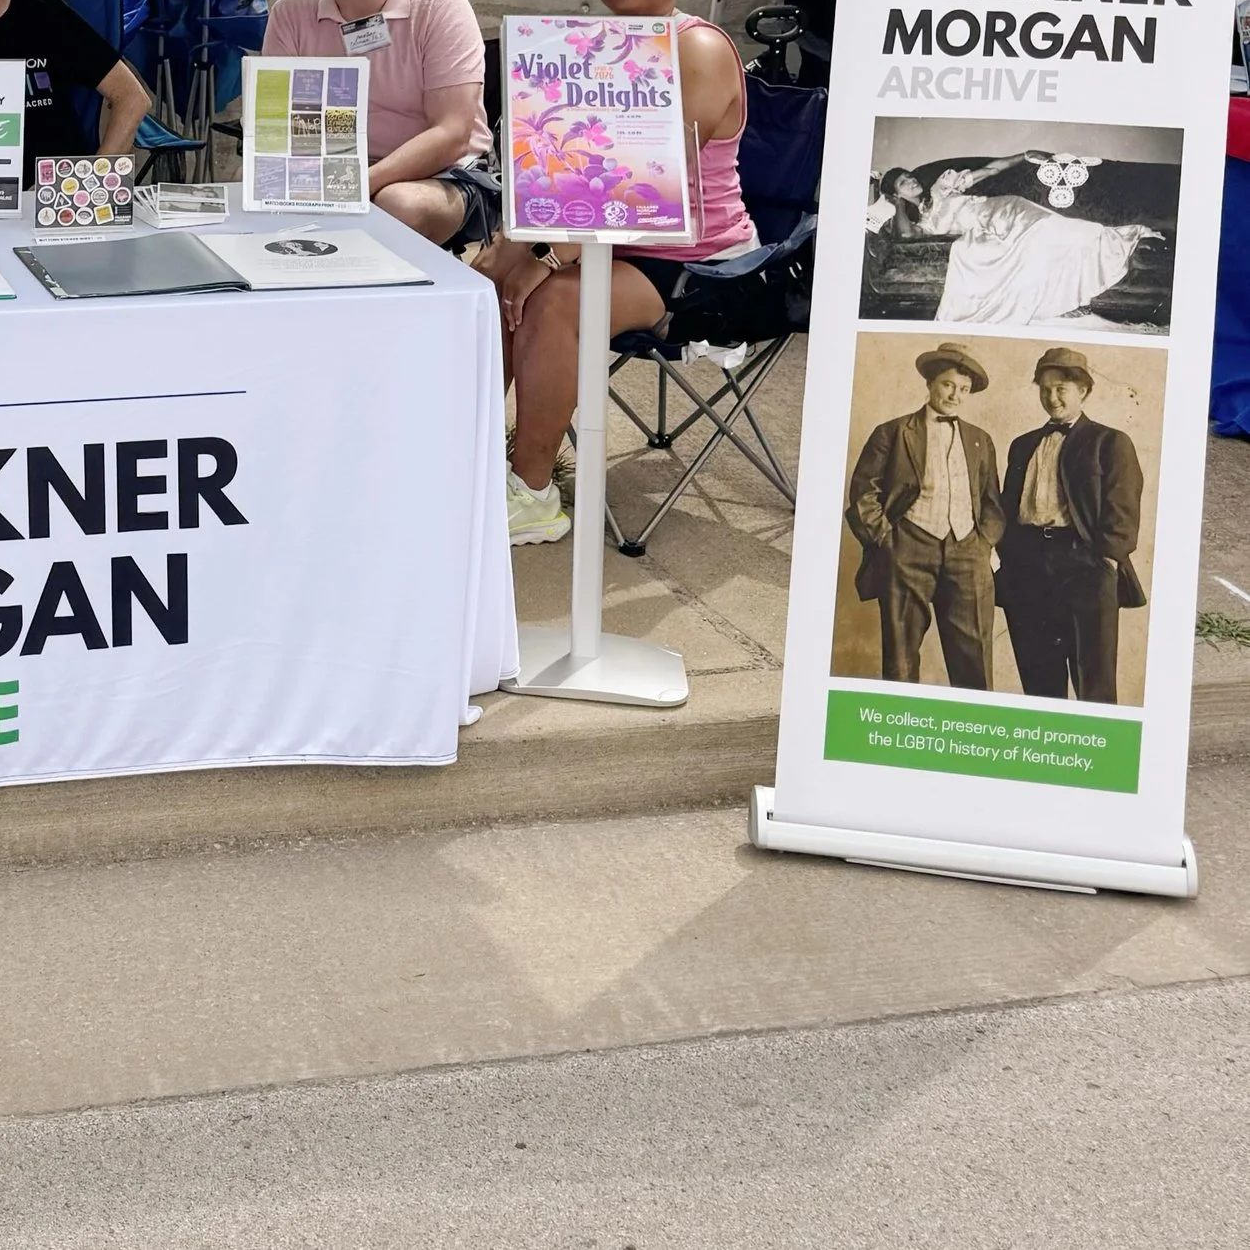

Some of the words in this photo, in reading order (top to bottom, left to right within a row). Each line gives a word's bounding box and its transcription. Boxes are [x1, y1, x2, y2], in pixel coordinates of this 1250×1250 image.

[882, 8, 1157, 64] MORGAN
[26, 58, 47, 68] ON
[518, 54, 593, 80] Violet
[566, 82, 672, 112] Delights
[877, 66, 1059, 102] ARCHIVE
[26, 98, 53, 108] ACRED
[859, 707, 882, 723] We
[886, 711, 938, 730] collect,
[941, 718, 1009, 739] preserve,
[1013, 726, 1040, 740] and
[1044, 730, 1107, 748] promote
[869, 731, 892, 747] the
[895, 734, 945, 753] LGBTQ
[949, 740, 1000, 761] history
[1003, 747, 1019, 759] of
[1022, 749, 1094, 771] Kentucky.
